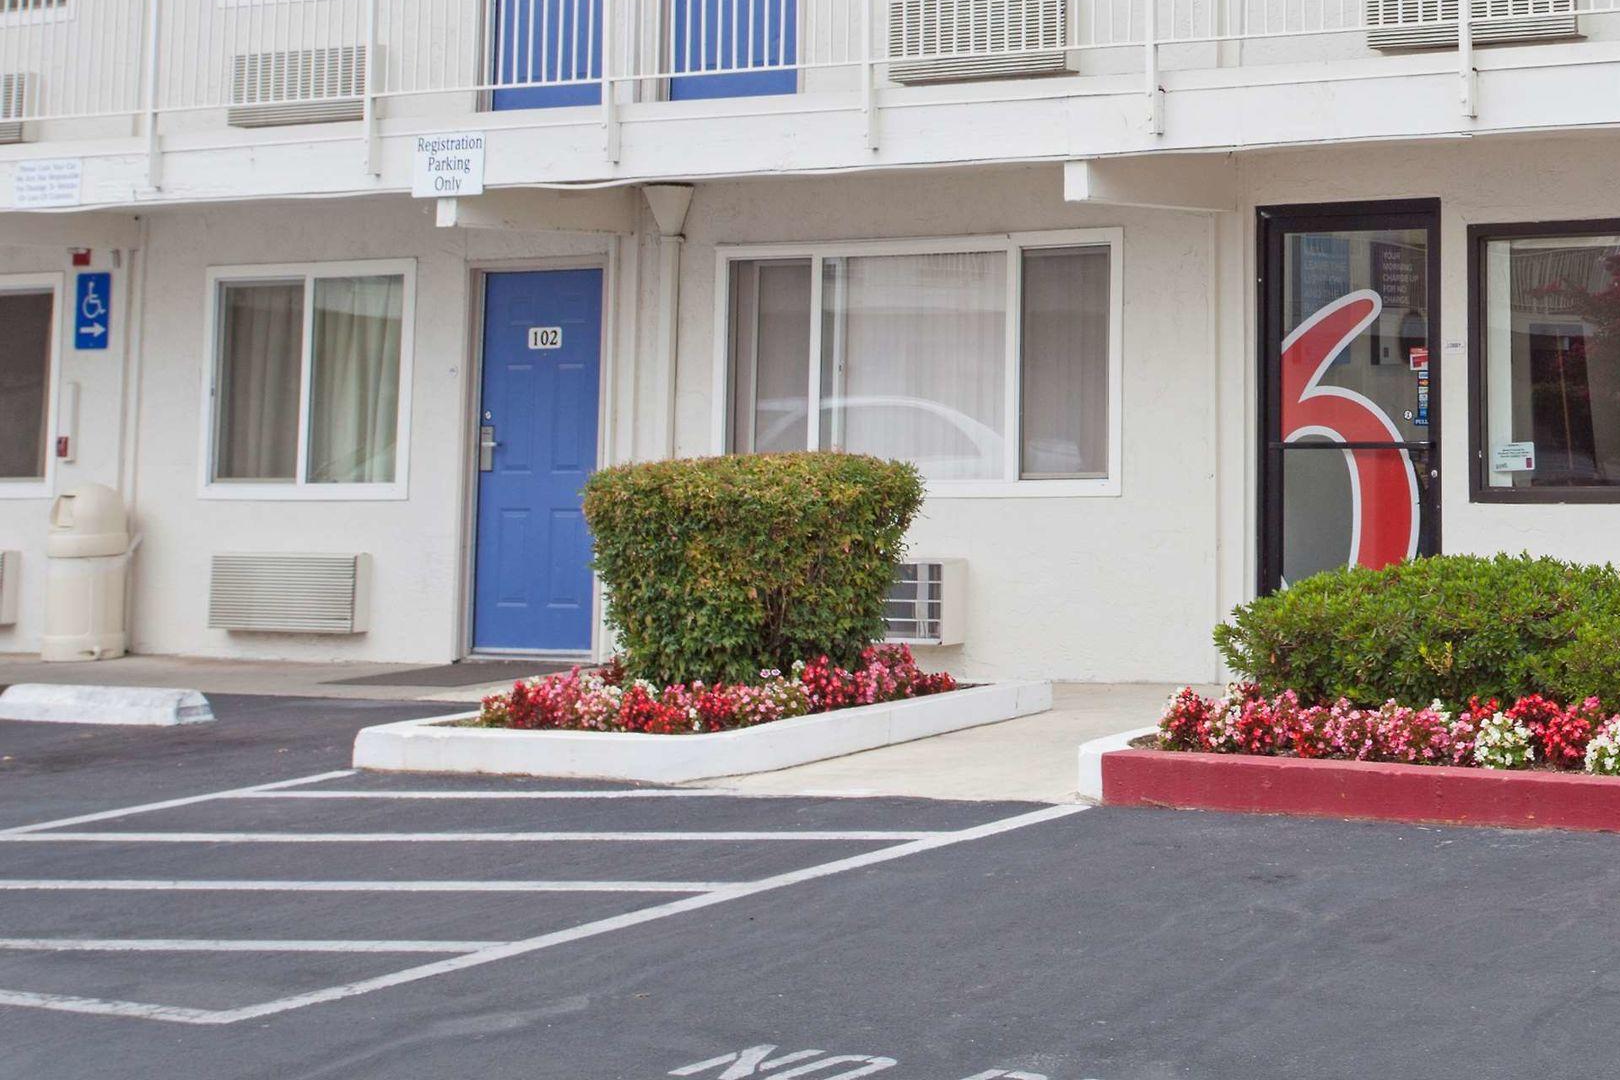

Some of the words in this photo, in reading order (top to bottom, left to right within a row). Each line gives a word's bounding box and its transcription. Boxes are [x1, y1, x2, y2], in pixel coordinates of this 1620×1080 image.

[417, 136, 482, 155] Registration
[428, 156, 470, 174] Parking
[434, 176, 462, 193] Only
[533, 330, 558, 346] 102
